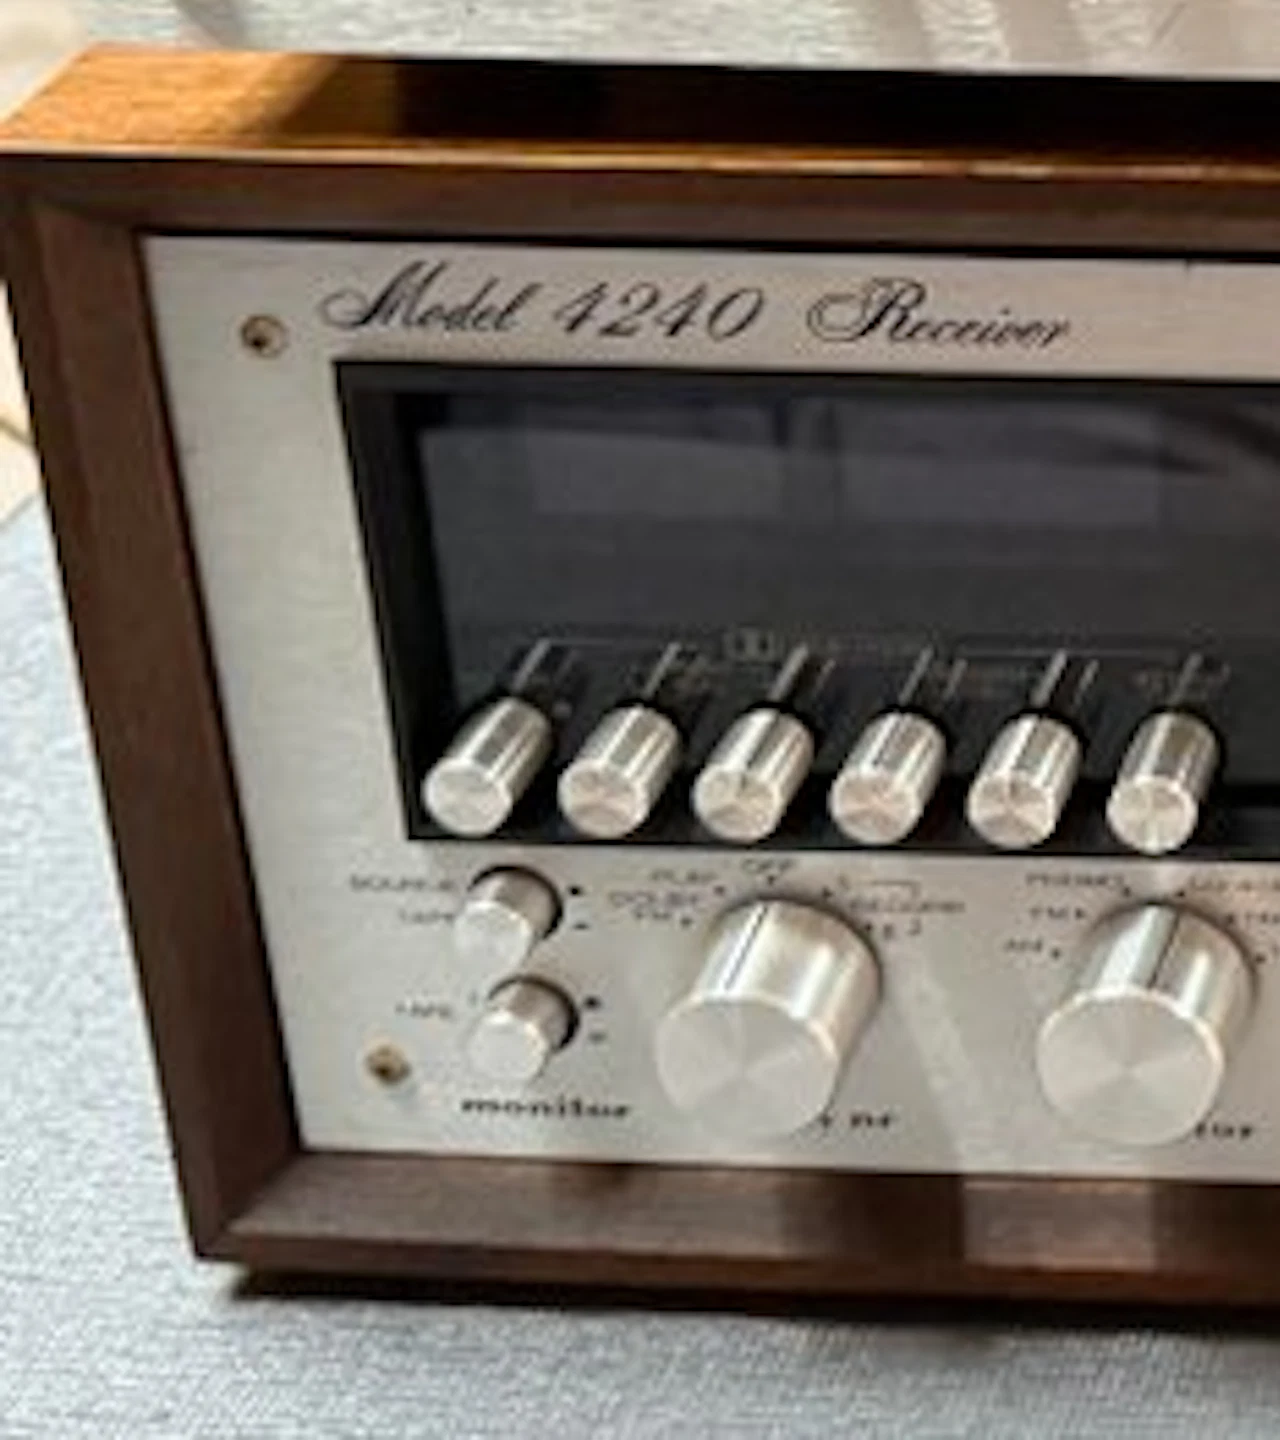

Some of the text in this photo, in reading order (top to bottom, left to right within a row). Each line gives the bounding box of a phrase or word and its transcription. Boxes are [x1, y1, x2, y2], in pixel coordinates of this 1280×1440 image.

[321, 259, 1071, 346] Model 4240 Receiver
[460, 1095, 632, 1121] monitor
